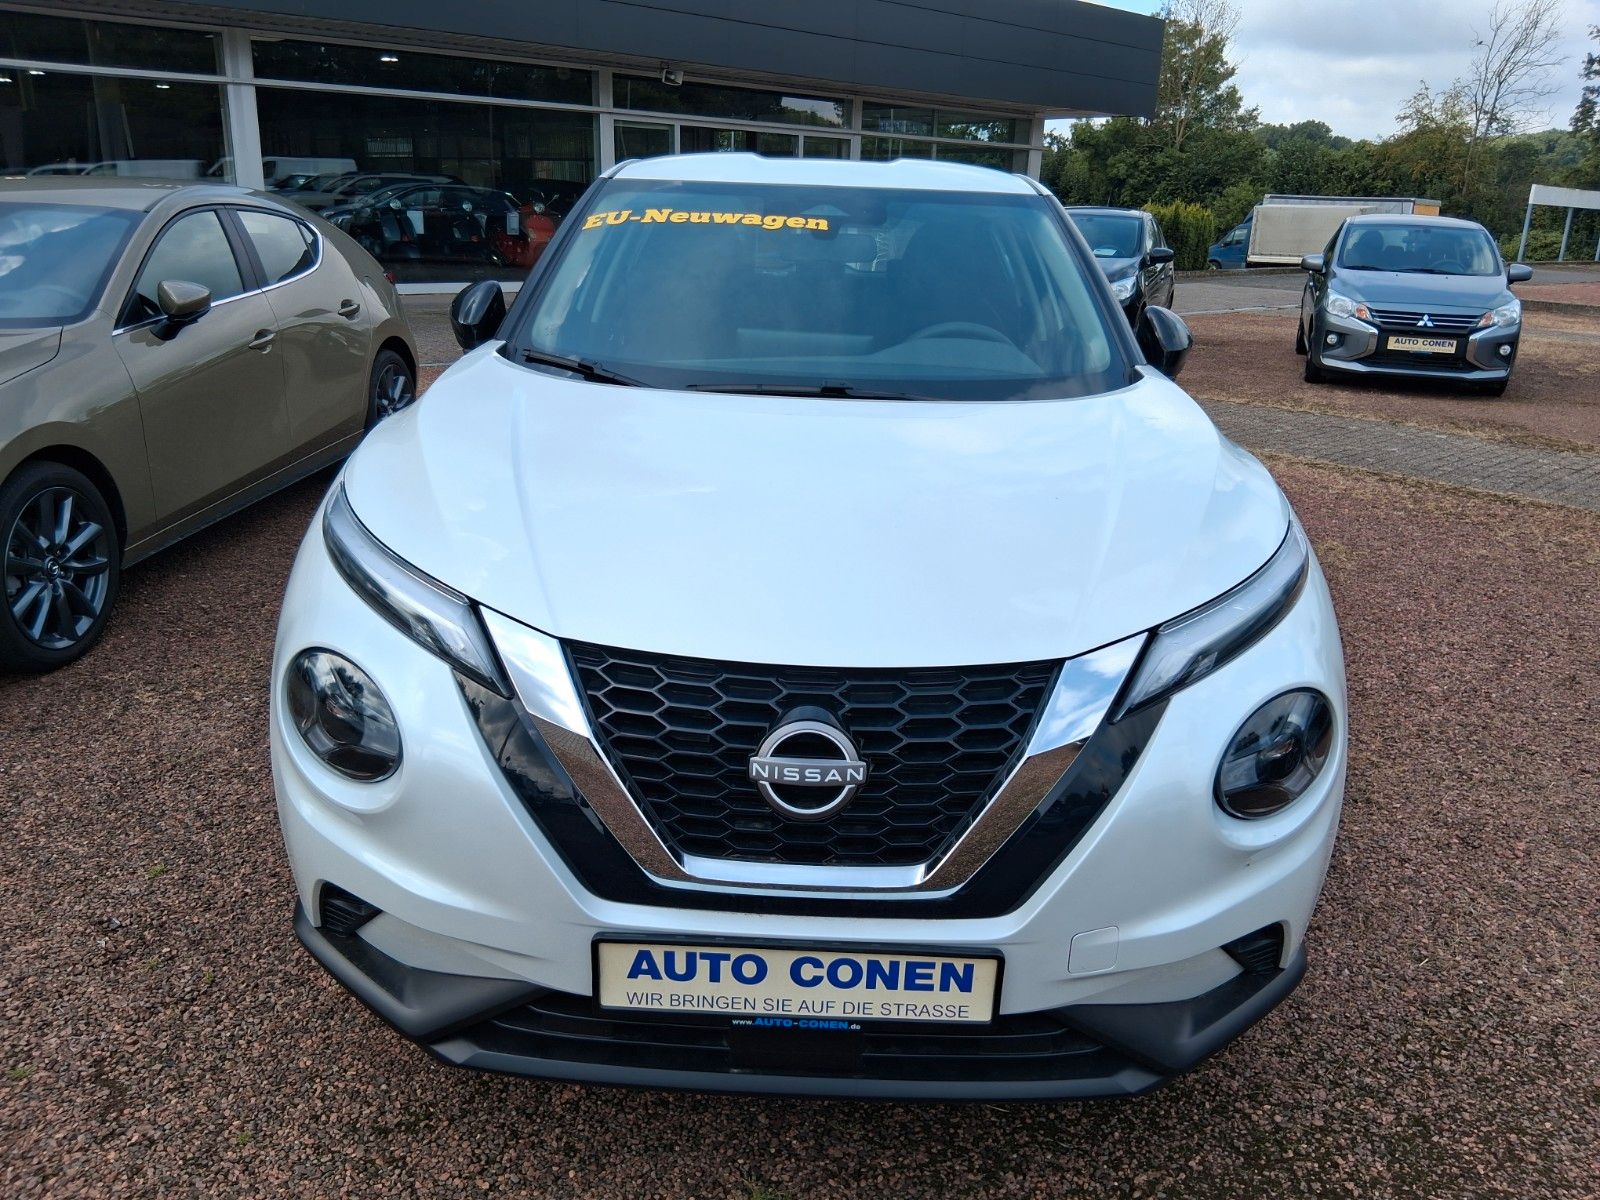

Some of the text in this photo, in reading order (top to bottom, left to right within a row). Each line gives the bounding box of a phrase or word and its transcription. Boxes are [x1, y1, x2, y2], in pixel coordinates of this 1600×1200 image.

[582, 208, 828, 231] EU-Neuwagen
[1422, 339, 1454, 347] CONEN
[752, 762, 863, 783] NISSAN
[626, 949, 975, 993] AUTO CONEN
[626, 991, 970, 1019] WIR BRINGEN SIE AUF DIE STRASSE
[732, 1017, 861, 1031] www.AUTO-CONEN.de
